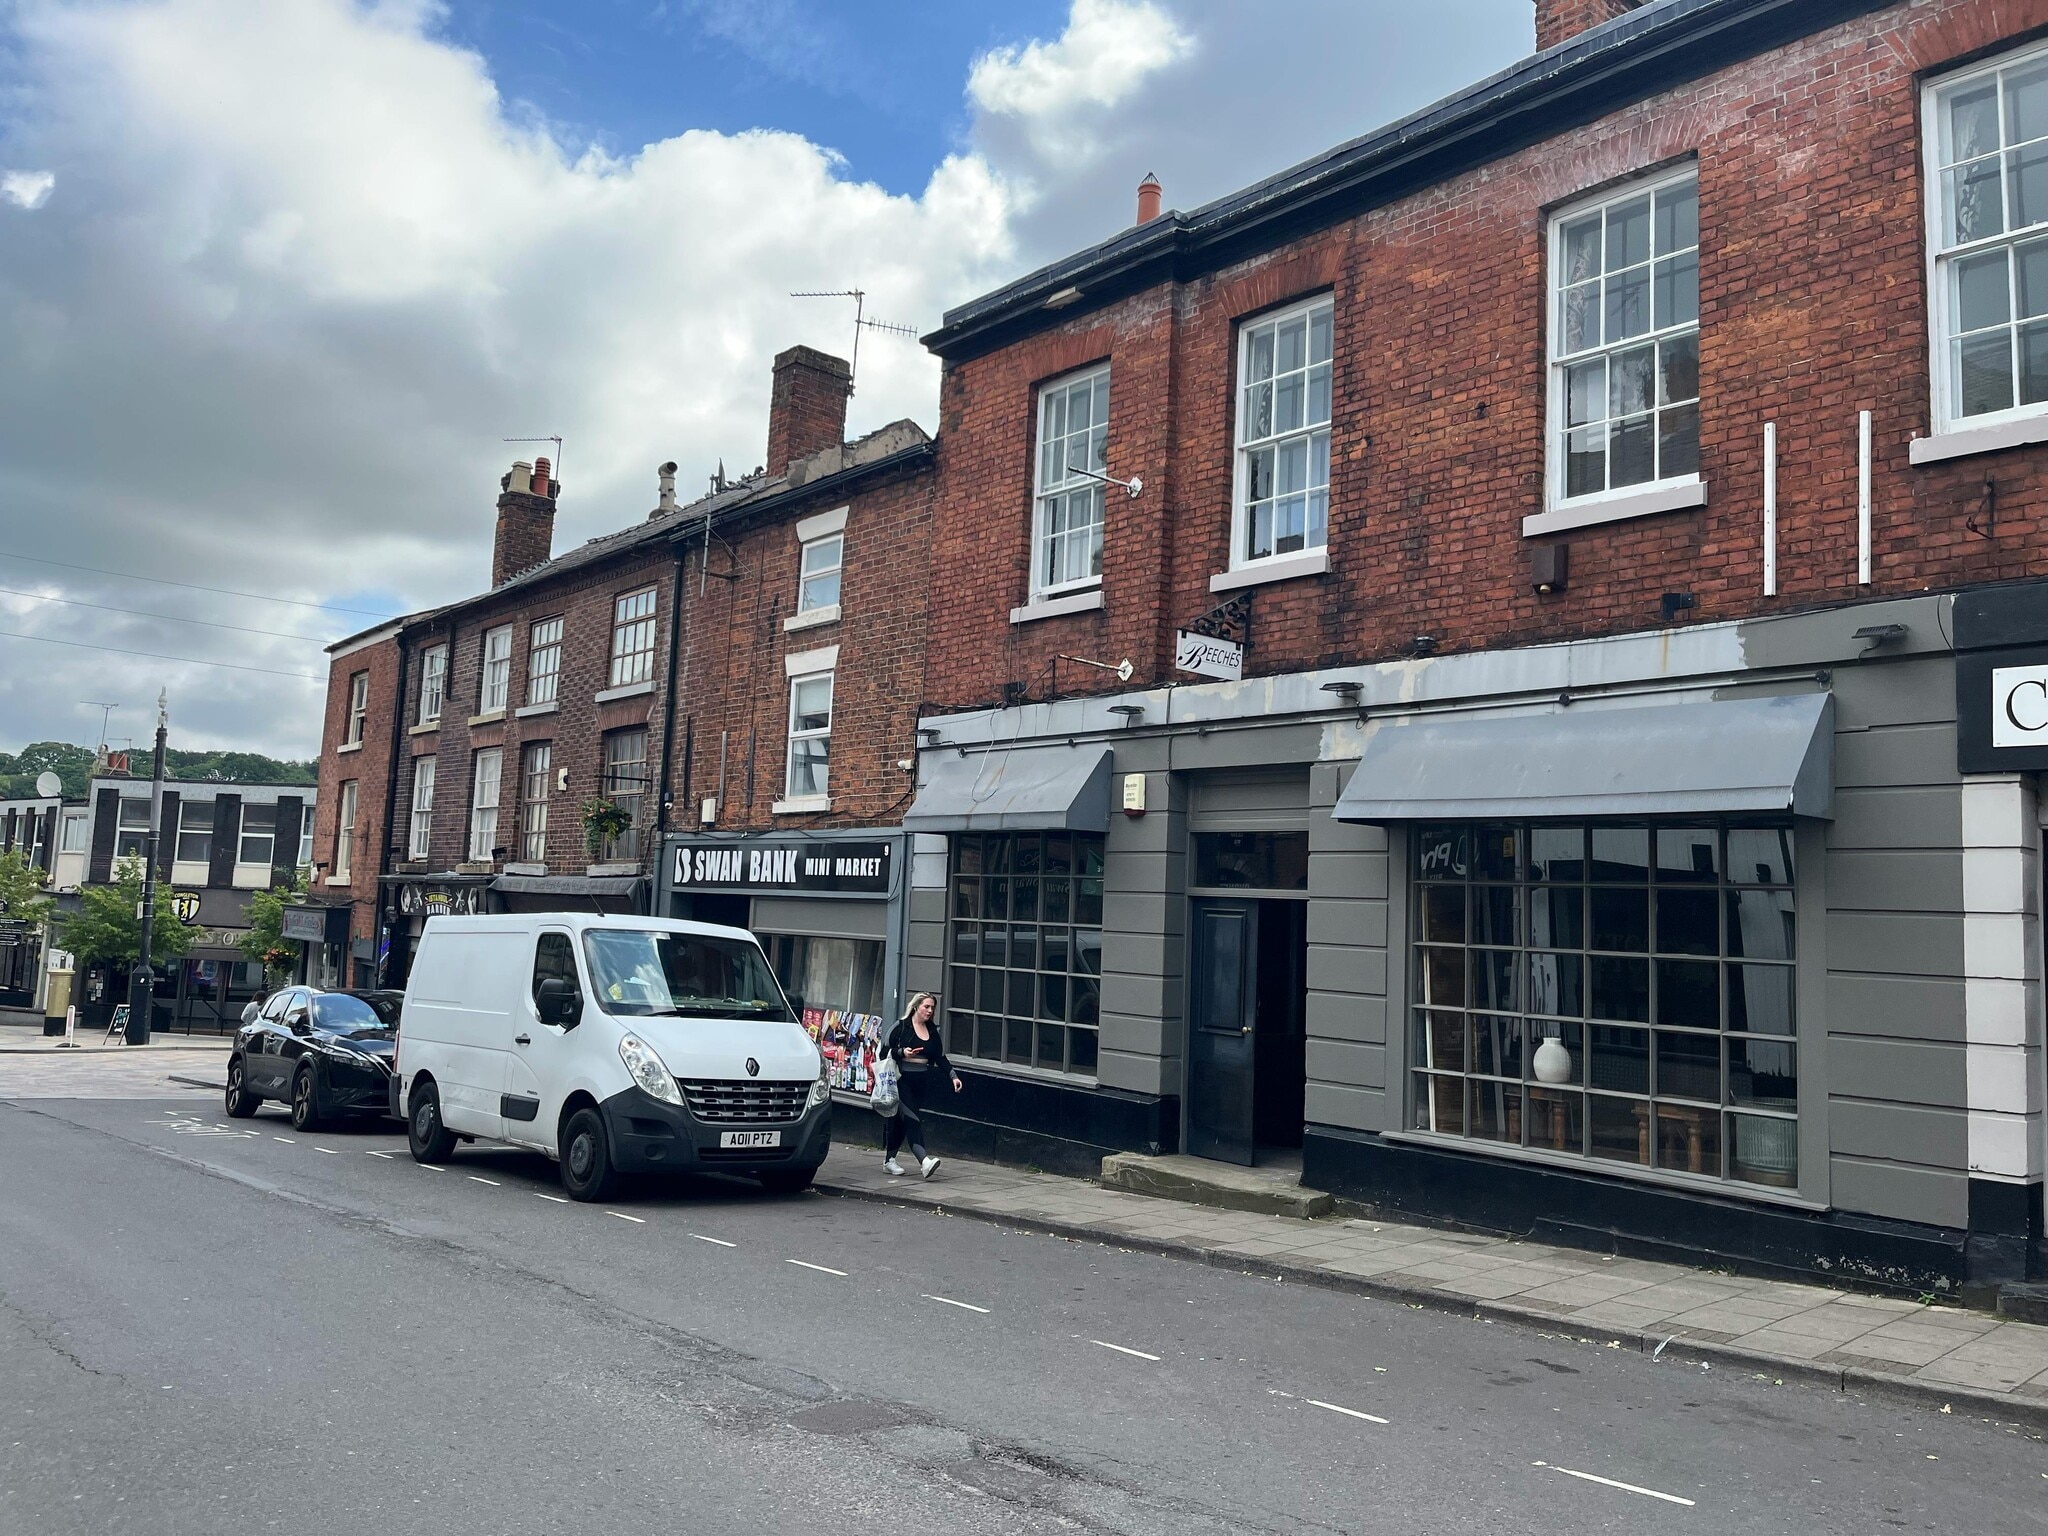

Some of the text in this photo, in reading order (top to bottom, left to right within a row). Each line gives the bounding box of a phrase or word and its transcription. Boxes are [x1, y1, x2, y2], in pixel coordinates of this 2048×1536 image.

[1177, 641, 1242, 670] BEECHES
[2005, 678, 2048, 732] C
[884, 845, 890, 856] 9
[694, 850, 743, 882] SWAN
[749, 849, 798, 883] BANK
[805, 857, 830, 876] MINI
[835, 857, 882, 877] MARKET
[753, 1133, 773, 1144] PTZ
